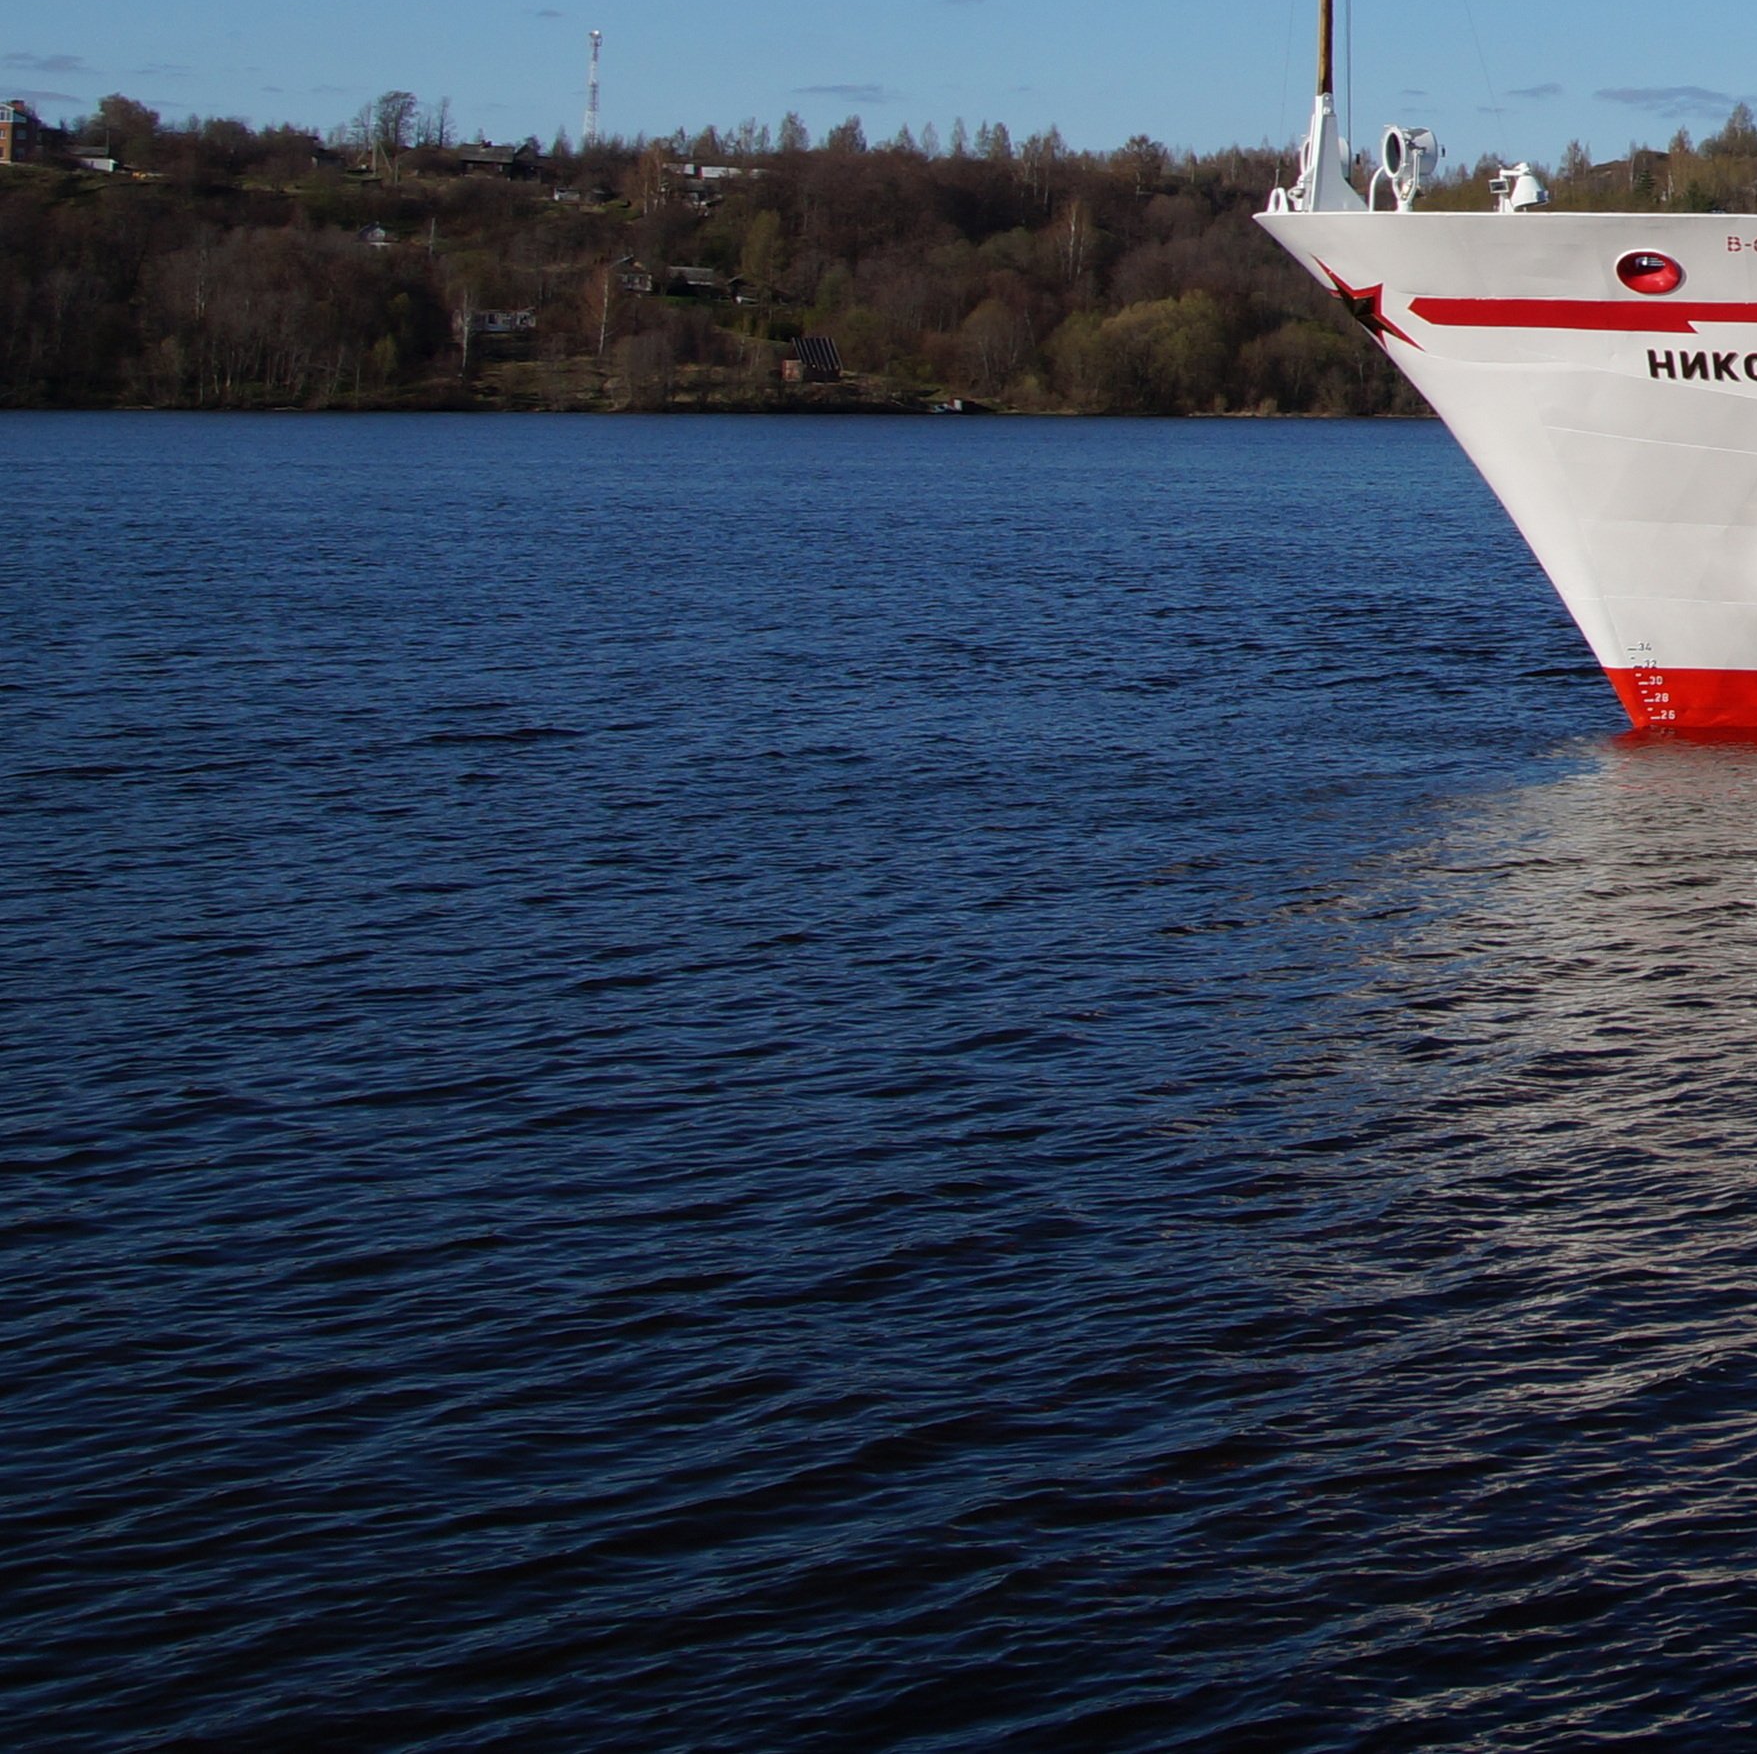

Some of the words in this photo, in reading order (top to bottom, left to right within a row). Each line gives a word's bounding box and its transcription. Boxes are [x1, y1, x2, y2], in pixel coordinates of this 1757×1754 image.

[1649, 675, 1663, 686] 30
[1654, 692, 1669, 703] 28
[1660, 709, 1676, 720] 26
